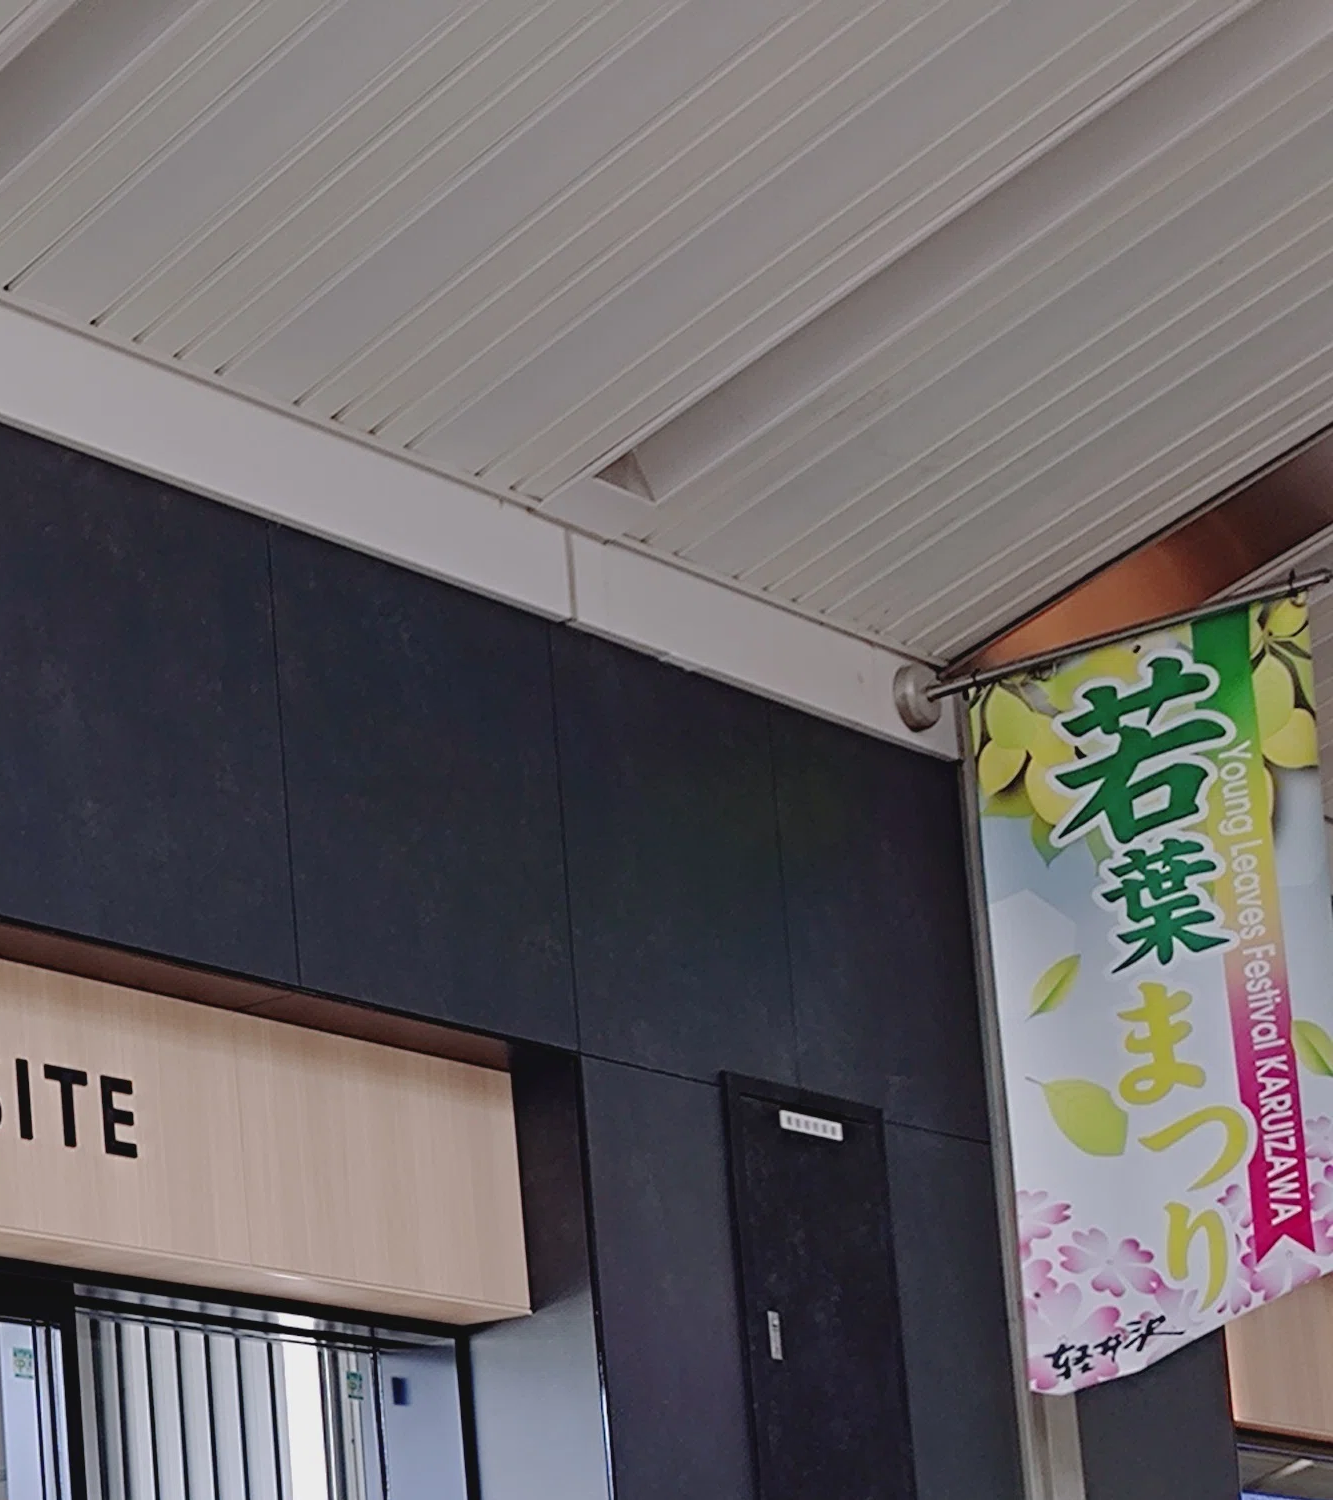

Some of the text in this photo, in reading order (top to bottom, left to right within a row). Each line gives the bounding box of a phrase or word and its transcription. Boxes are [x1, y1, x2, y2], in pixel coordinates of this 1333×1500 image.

[1218, 739, 1303, 1226] Young Leaves Festival KARUIZAWA
